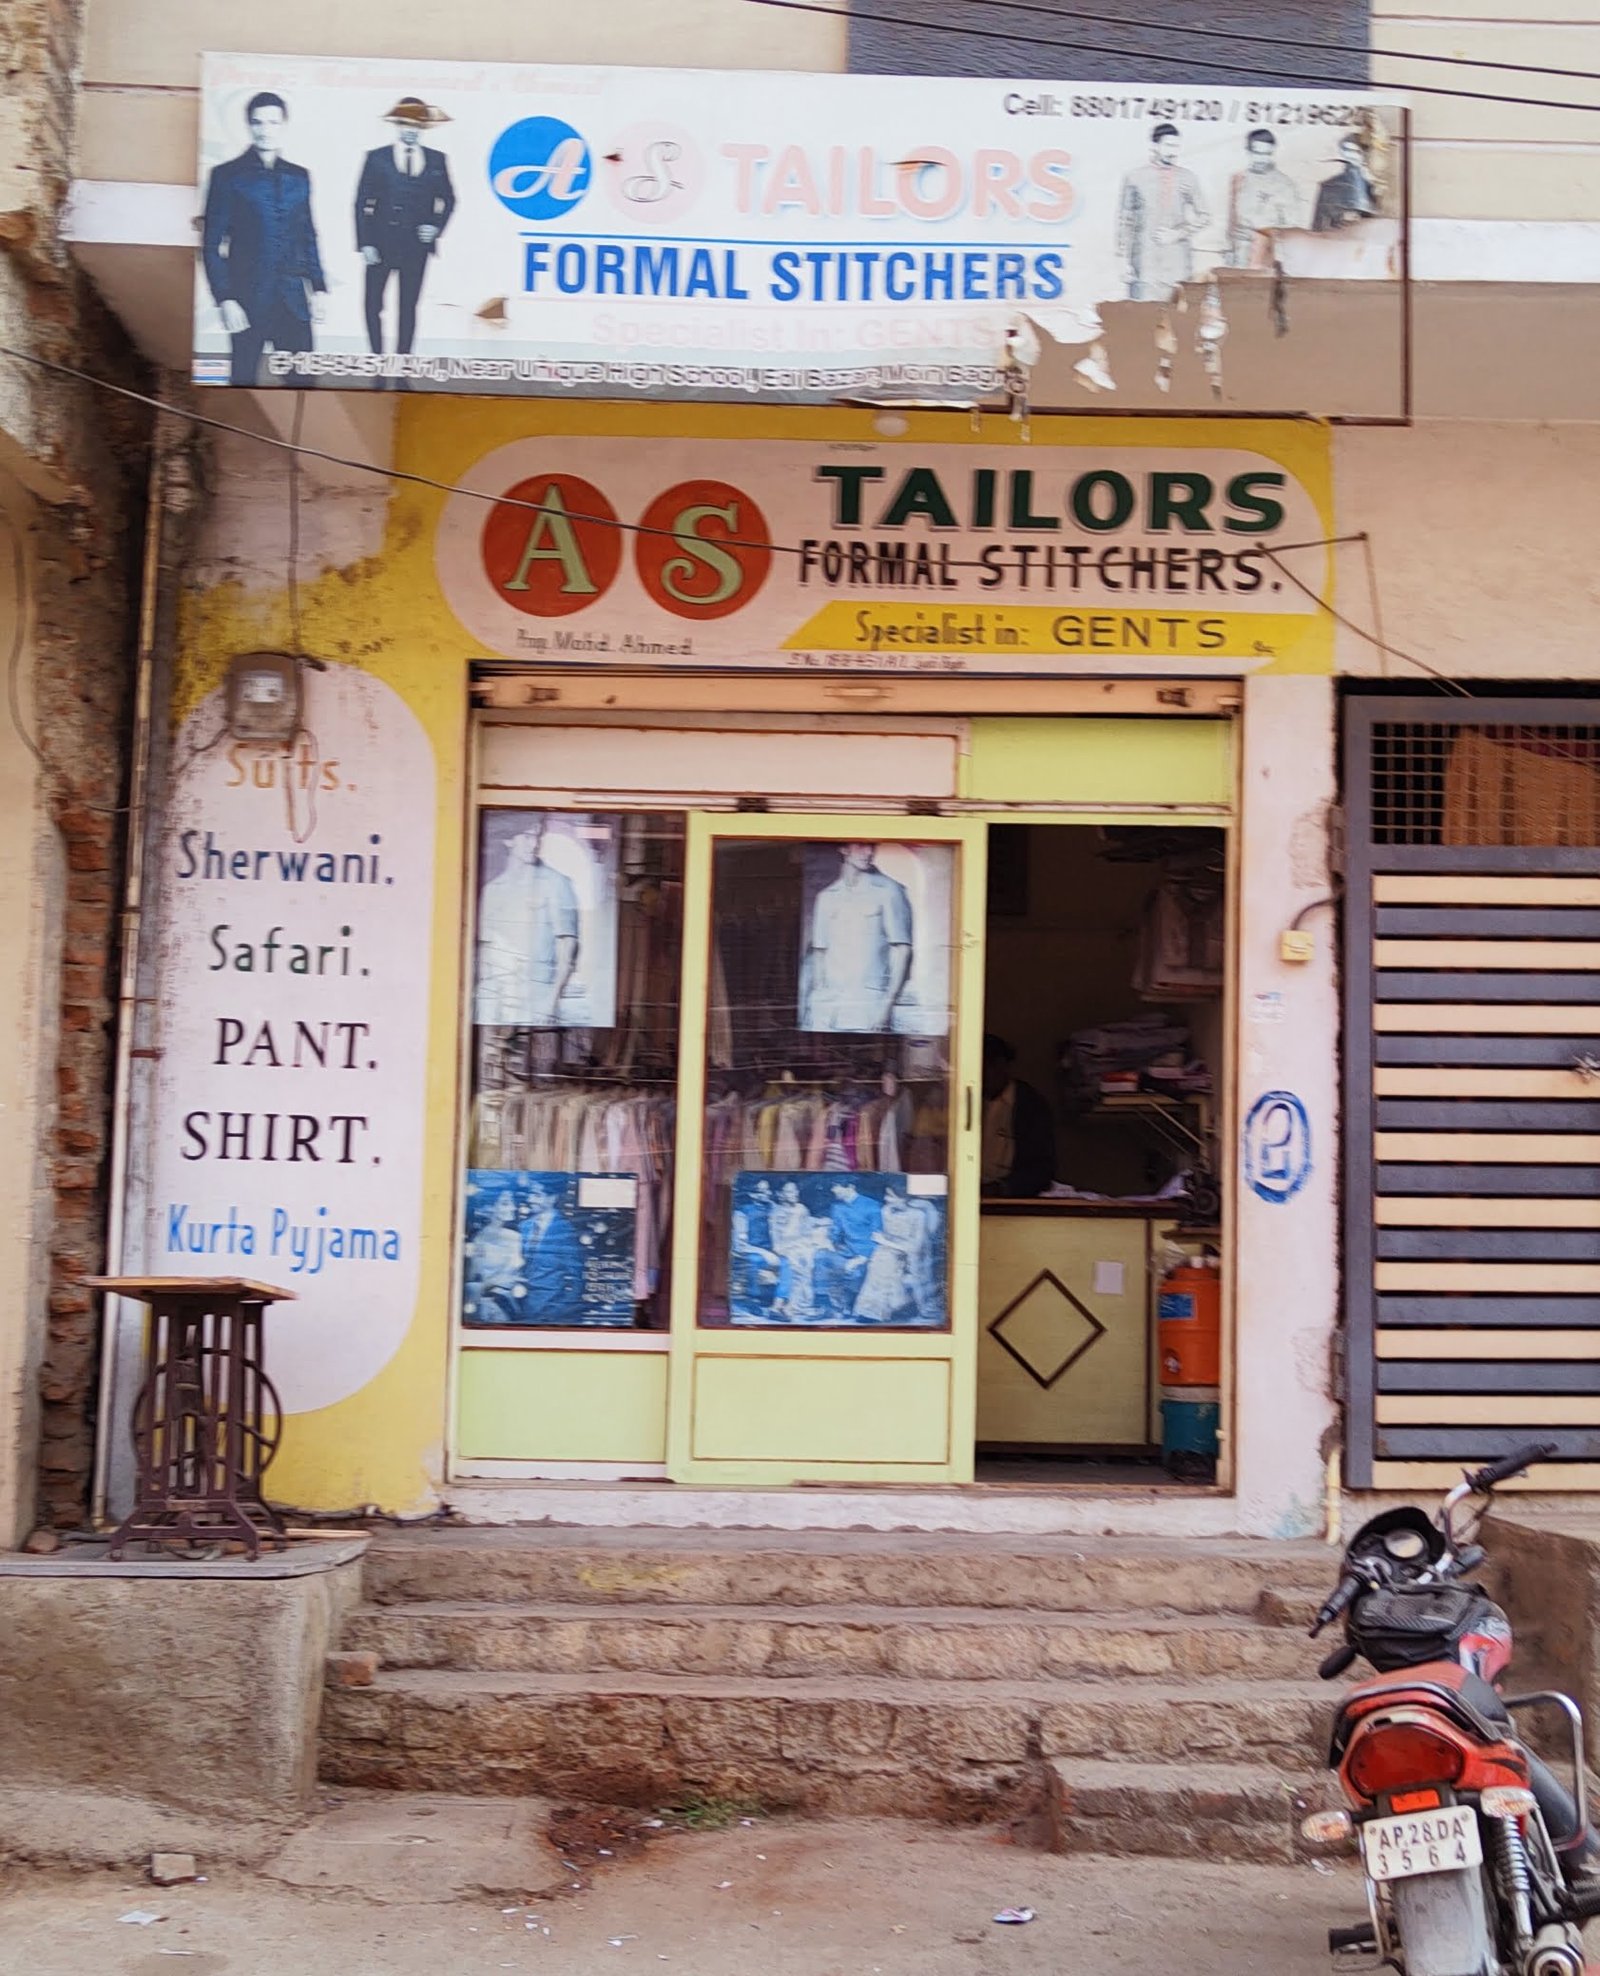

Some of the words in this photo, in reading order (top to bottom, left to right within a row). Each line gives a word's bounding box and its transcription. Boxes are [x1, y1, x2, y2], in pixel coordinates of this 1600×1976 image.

[492, 137, 588, 201] A
[620, 140, 686, 202] S
[720, 142, 1076, 222] TAILORS
[524, 242, 748, 300] FORMAL
[769, 250, 1066, 301] STITCHERS
[812, 465, 1287, 535] TAILORS
[504, 483, 599, 593] A
[661, 503, 745, 605] S
[800, 538, 958, 588] FORMAL
[855, 610, 985, 652] Specialist
[1053, 616, 1227, 649] GENTS
[176, 830, 395, 884] Sherwani.
[208, 924, 370, 976] Safari.
[213, 1017, 378, 1070] PANT.
[180, 1110, 381, 1164] SHIRT.
[167, 1203, 256, 1255] Kurta
[269, 1206, 401, 1274] Pyjama
